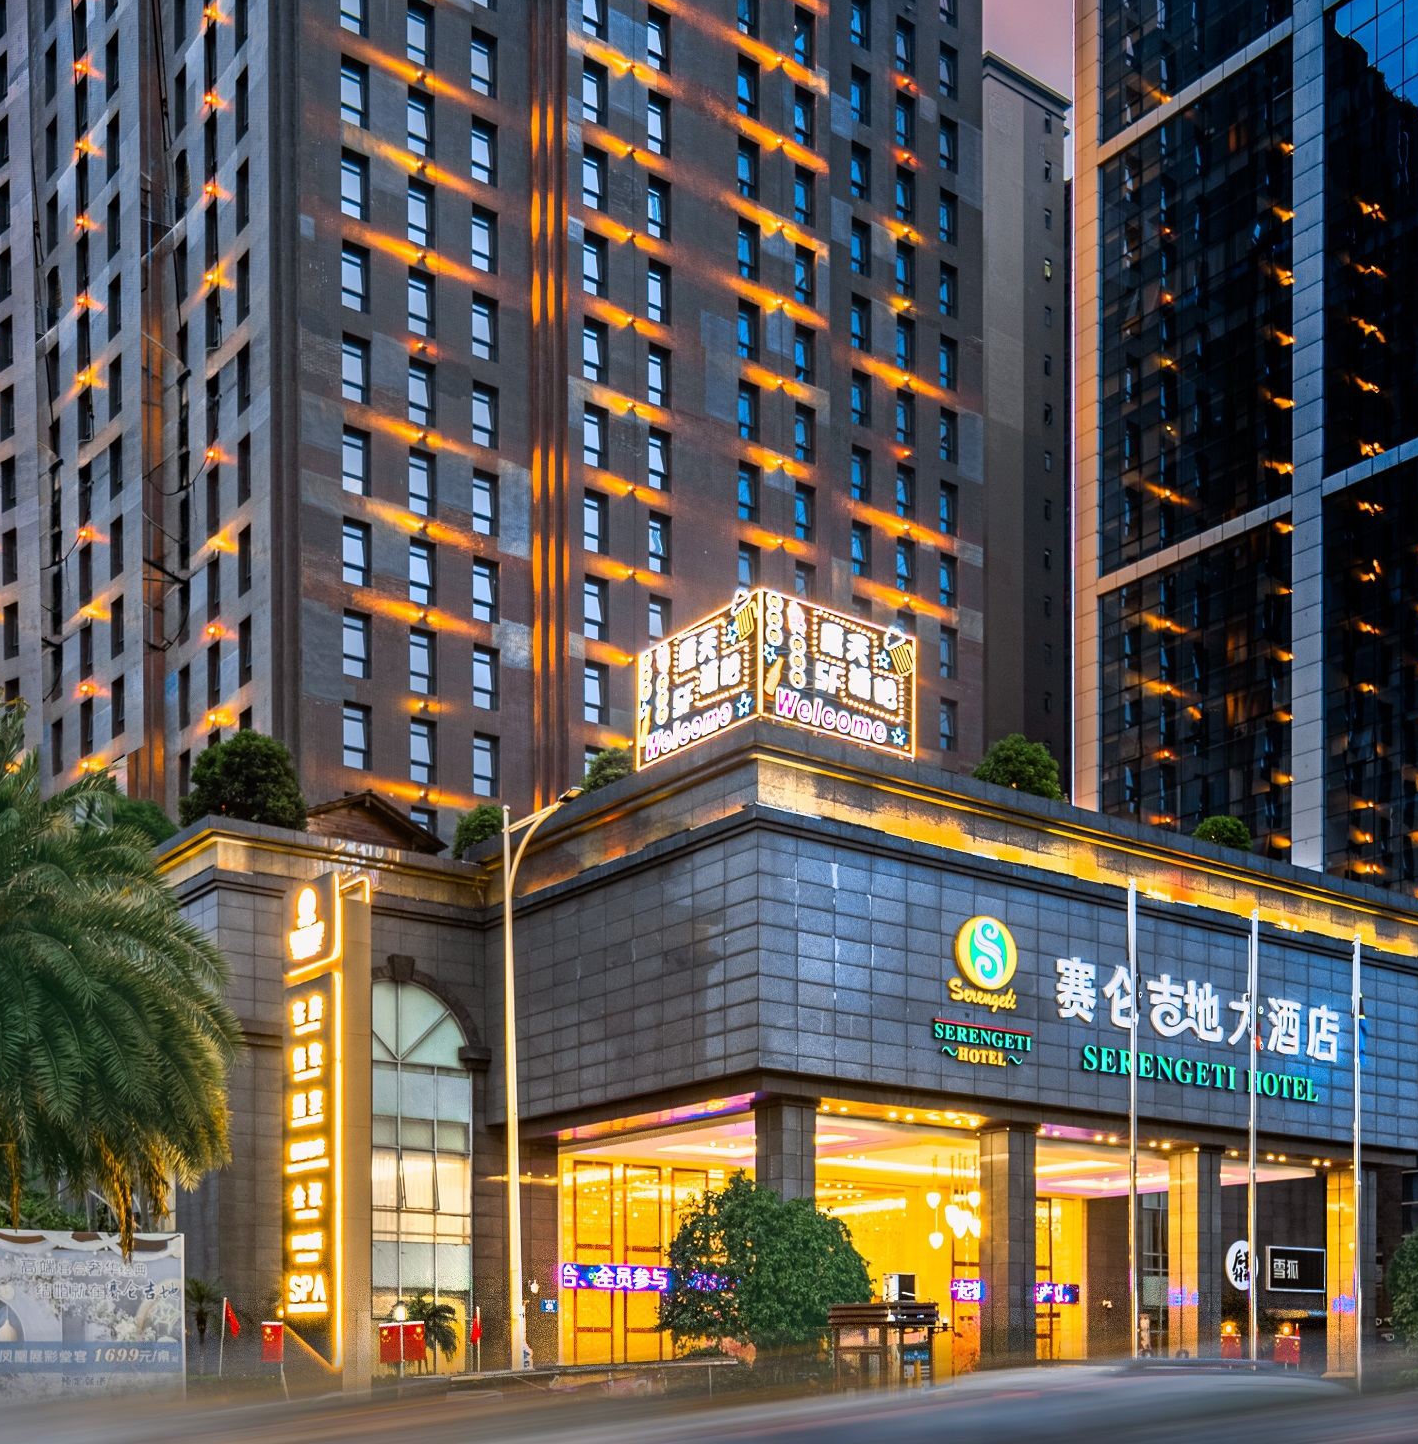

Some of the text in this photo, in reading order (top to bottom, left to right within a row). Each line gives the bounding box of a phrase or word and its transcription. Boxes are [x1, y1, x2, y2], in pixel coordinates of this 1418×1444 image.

[645, 702, 733, 761] Welcome
[775, 687, 888, 743] Welcome
[948, 977, 1017, 1013] Serengeti
[1056, 956, 1340, 1062] 赛仑吉地大酒店
[934, 1022, 1032, 1052] SERENGETI
[957, 1046, 1007, 1066] HOTEL
[1083, 1045, 1319, 1102] SERENGETI HOTEL
[1273, 1259, 1298, 1279] 雪狐
[289, 1274, 327, 1302] SPA
